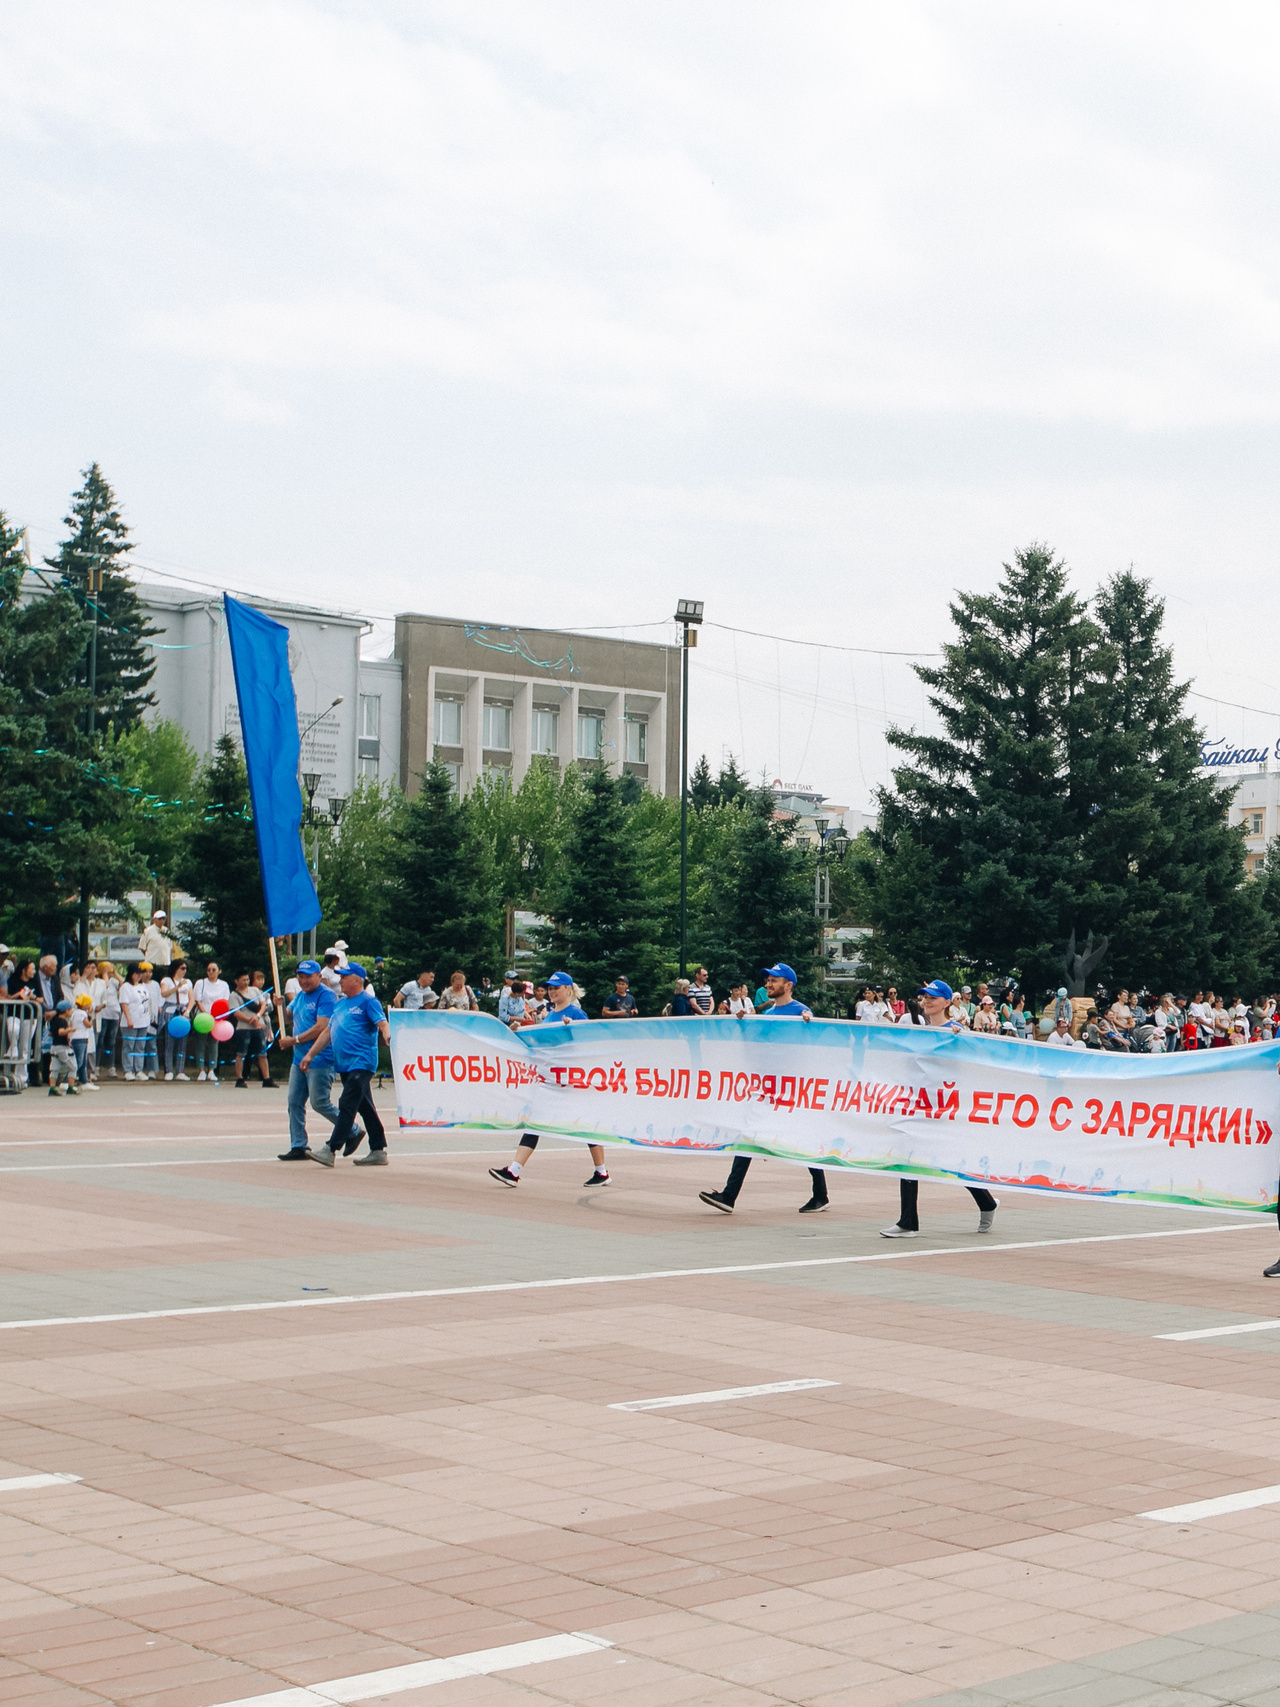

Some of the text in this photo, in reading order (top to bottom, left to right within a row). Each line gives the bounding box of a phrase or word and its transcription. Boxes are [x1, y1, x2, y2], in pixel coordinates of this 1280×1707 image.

[402, 1055, 501, 1083] «ЧТОБЫ
[550, 1061, 628, 1094] ТВОЙ
[635, 1068, 690, 1099] БЫЛ
[696, 1069, 712, 1101] В
[717, 1070, 830, 1113] ПОРЯДКЕ
[831, 1080, 960, 1121] НАЧИНАЙ
[968, 1090, 1039, 1129] ЕГО
[1049, 1096, 1074, 1131] С
[1081, 1098, 1273, 1149] ЗАРЯДКИ!»
